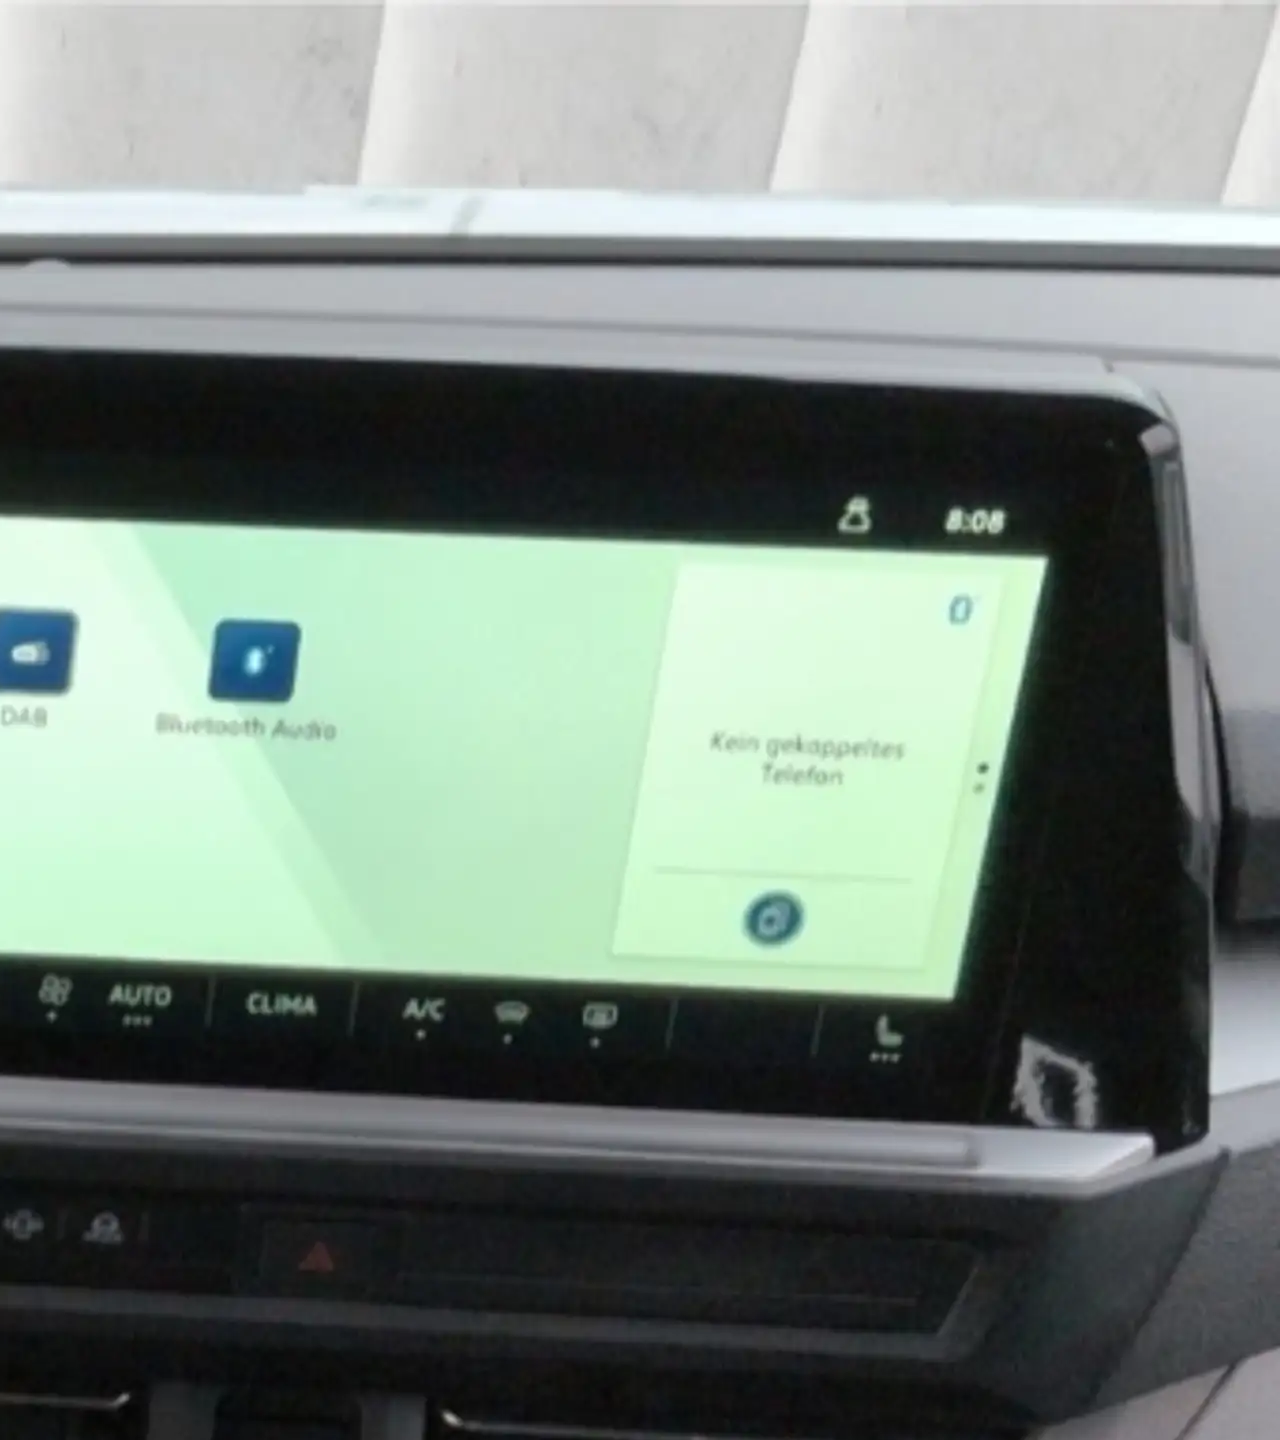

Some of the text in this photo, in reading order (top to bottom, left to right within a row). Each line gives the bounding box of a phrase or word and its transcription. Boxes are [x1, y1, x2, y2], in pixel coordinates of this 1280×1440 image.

[0, 705, 48, 728] DAB
[108, 983, 173, 1009] AUTO
[245, 991, 319, 1018] CLIMA
[401, 997, 446, 1023] A/C
